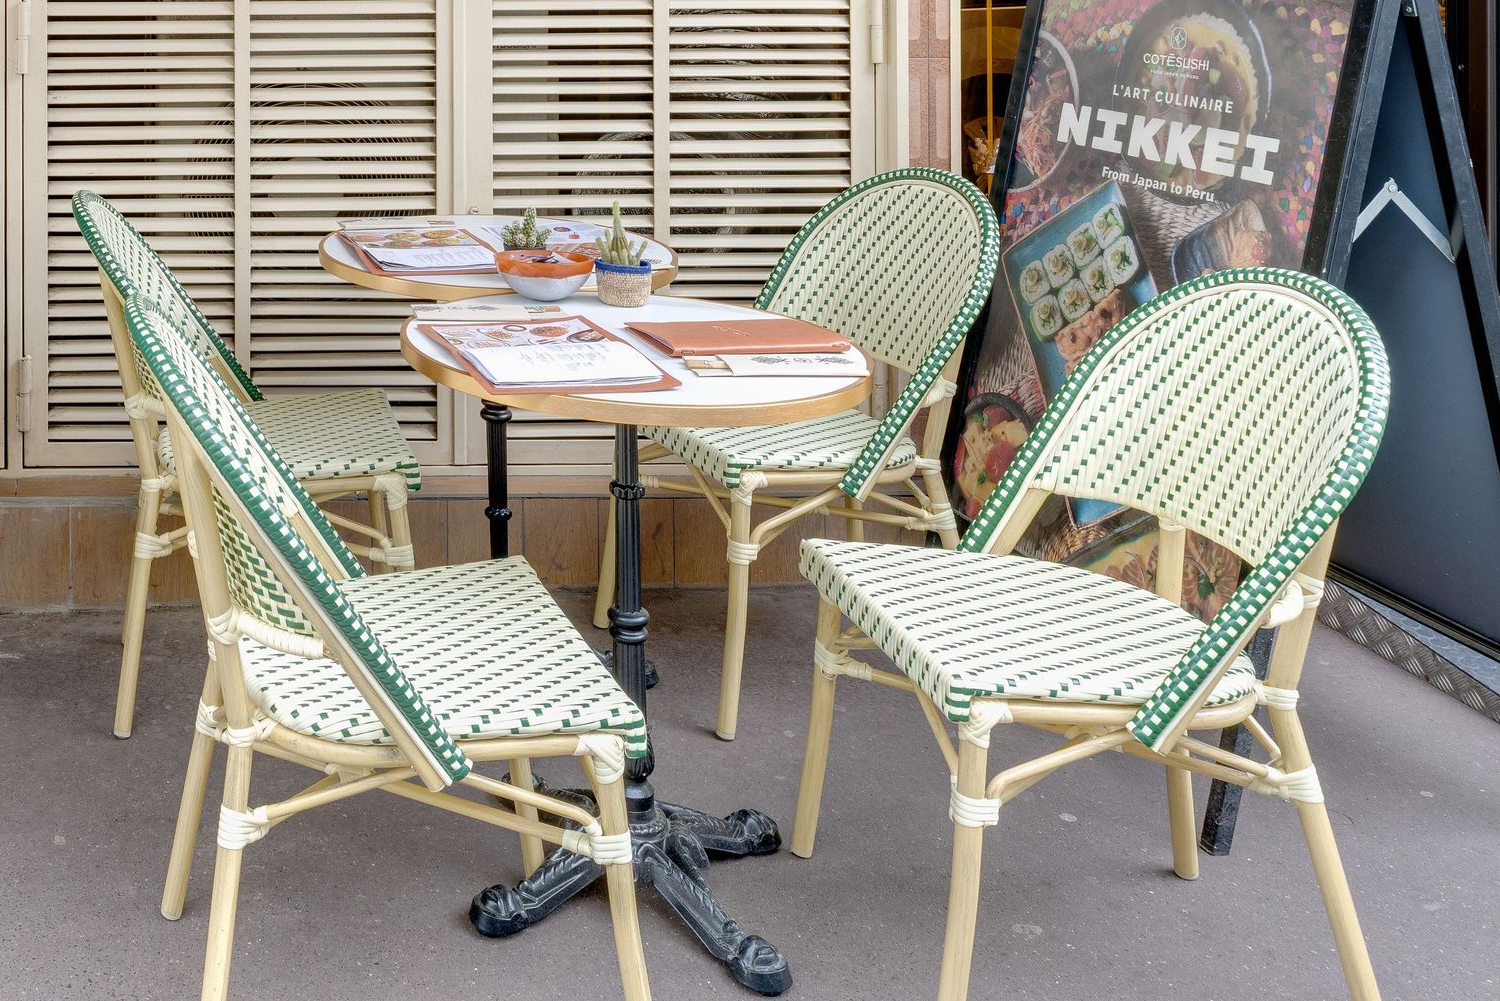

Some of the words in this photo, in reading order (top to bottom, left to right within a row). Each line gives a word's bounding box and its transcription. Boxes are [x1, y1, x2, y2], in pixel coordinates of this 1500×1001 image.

[1112, 84, 1150, 101] L'ART
[1155, 90, 1234, 114] CULINAIRE
[1056, 102, 1281, 186] NIKKEI
[1101, 166, 1130, 183] From
[1131, 172, 1167, 192] Japan
[1170, 182, 1183, 195] to
[1186, 184, 1215, 203] Peru
